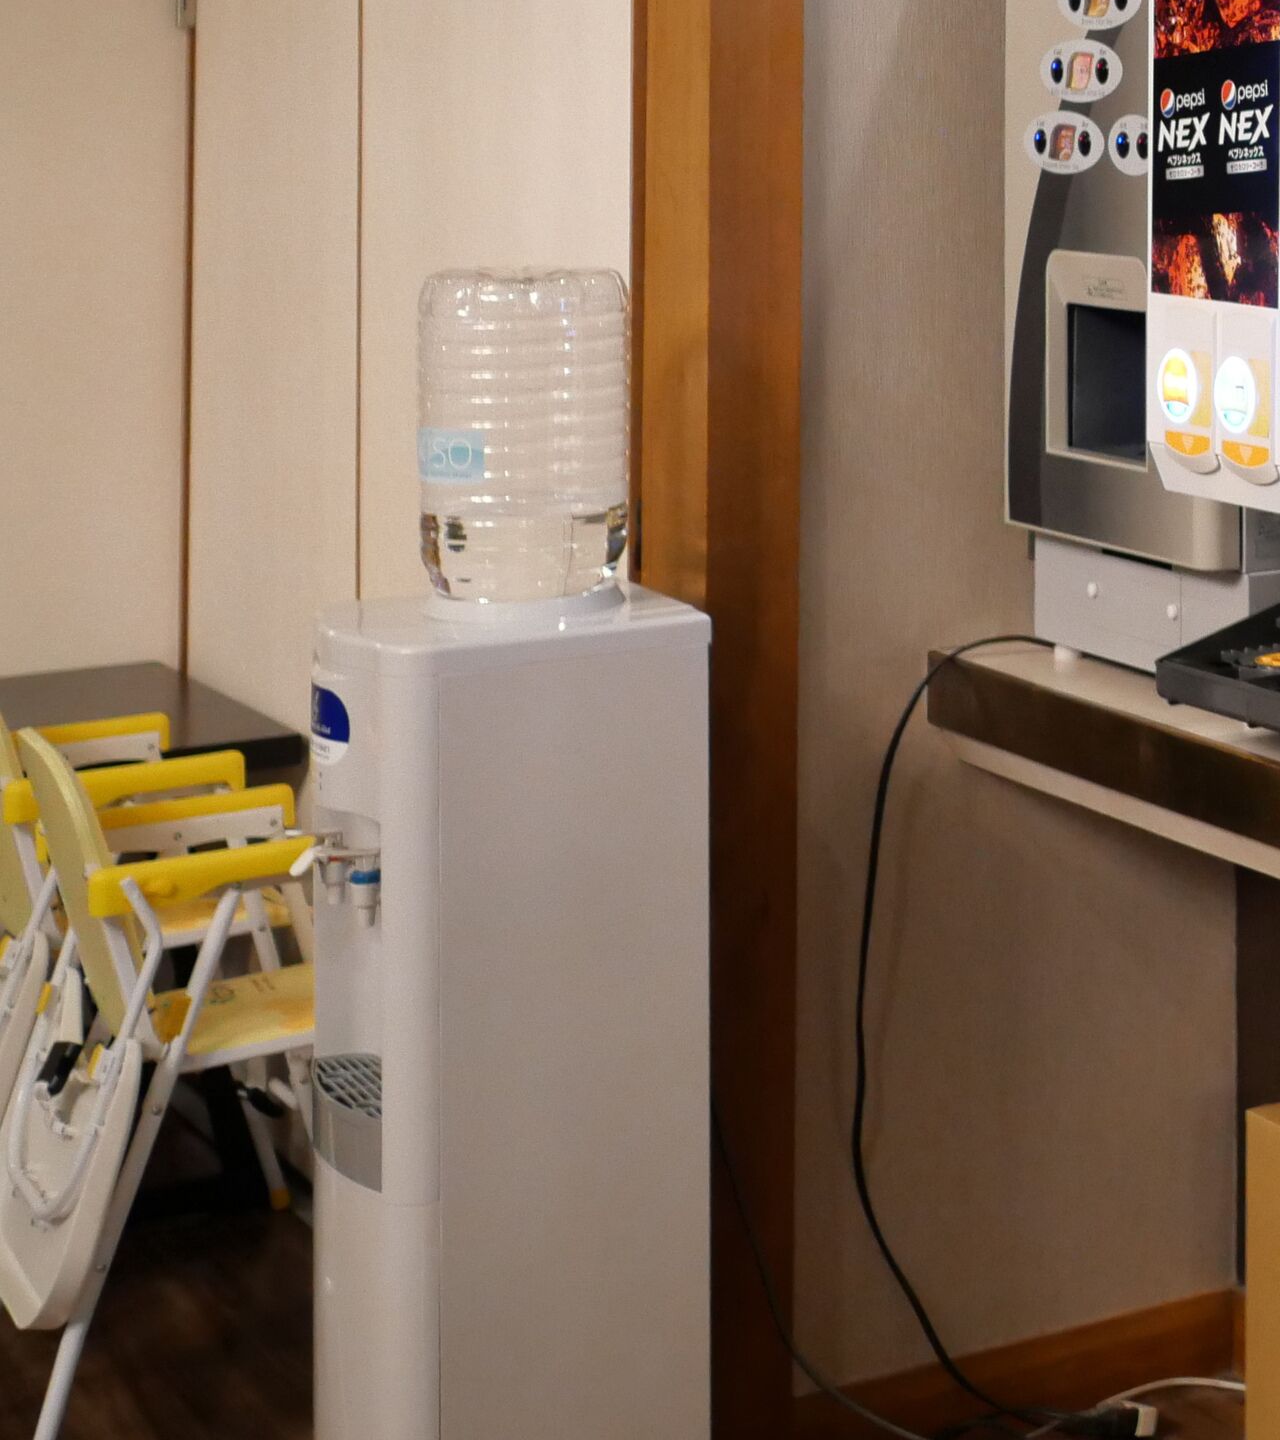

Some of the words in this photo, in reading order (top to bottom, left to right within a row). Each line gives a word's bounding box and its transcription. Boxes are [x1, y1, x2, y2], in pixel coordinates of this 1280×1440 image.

[1176, 88, 1206, 109] pepsi
[1237, 80, 1269, 104] pepsi
[1158, 112, 1210, 152] NEX
[1218, 104, 1274, 145] NEX
[1167, 152, 1202, 165] ペプシネックス
[1228, 146, 1264, 159] ペプシネックス
